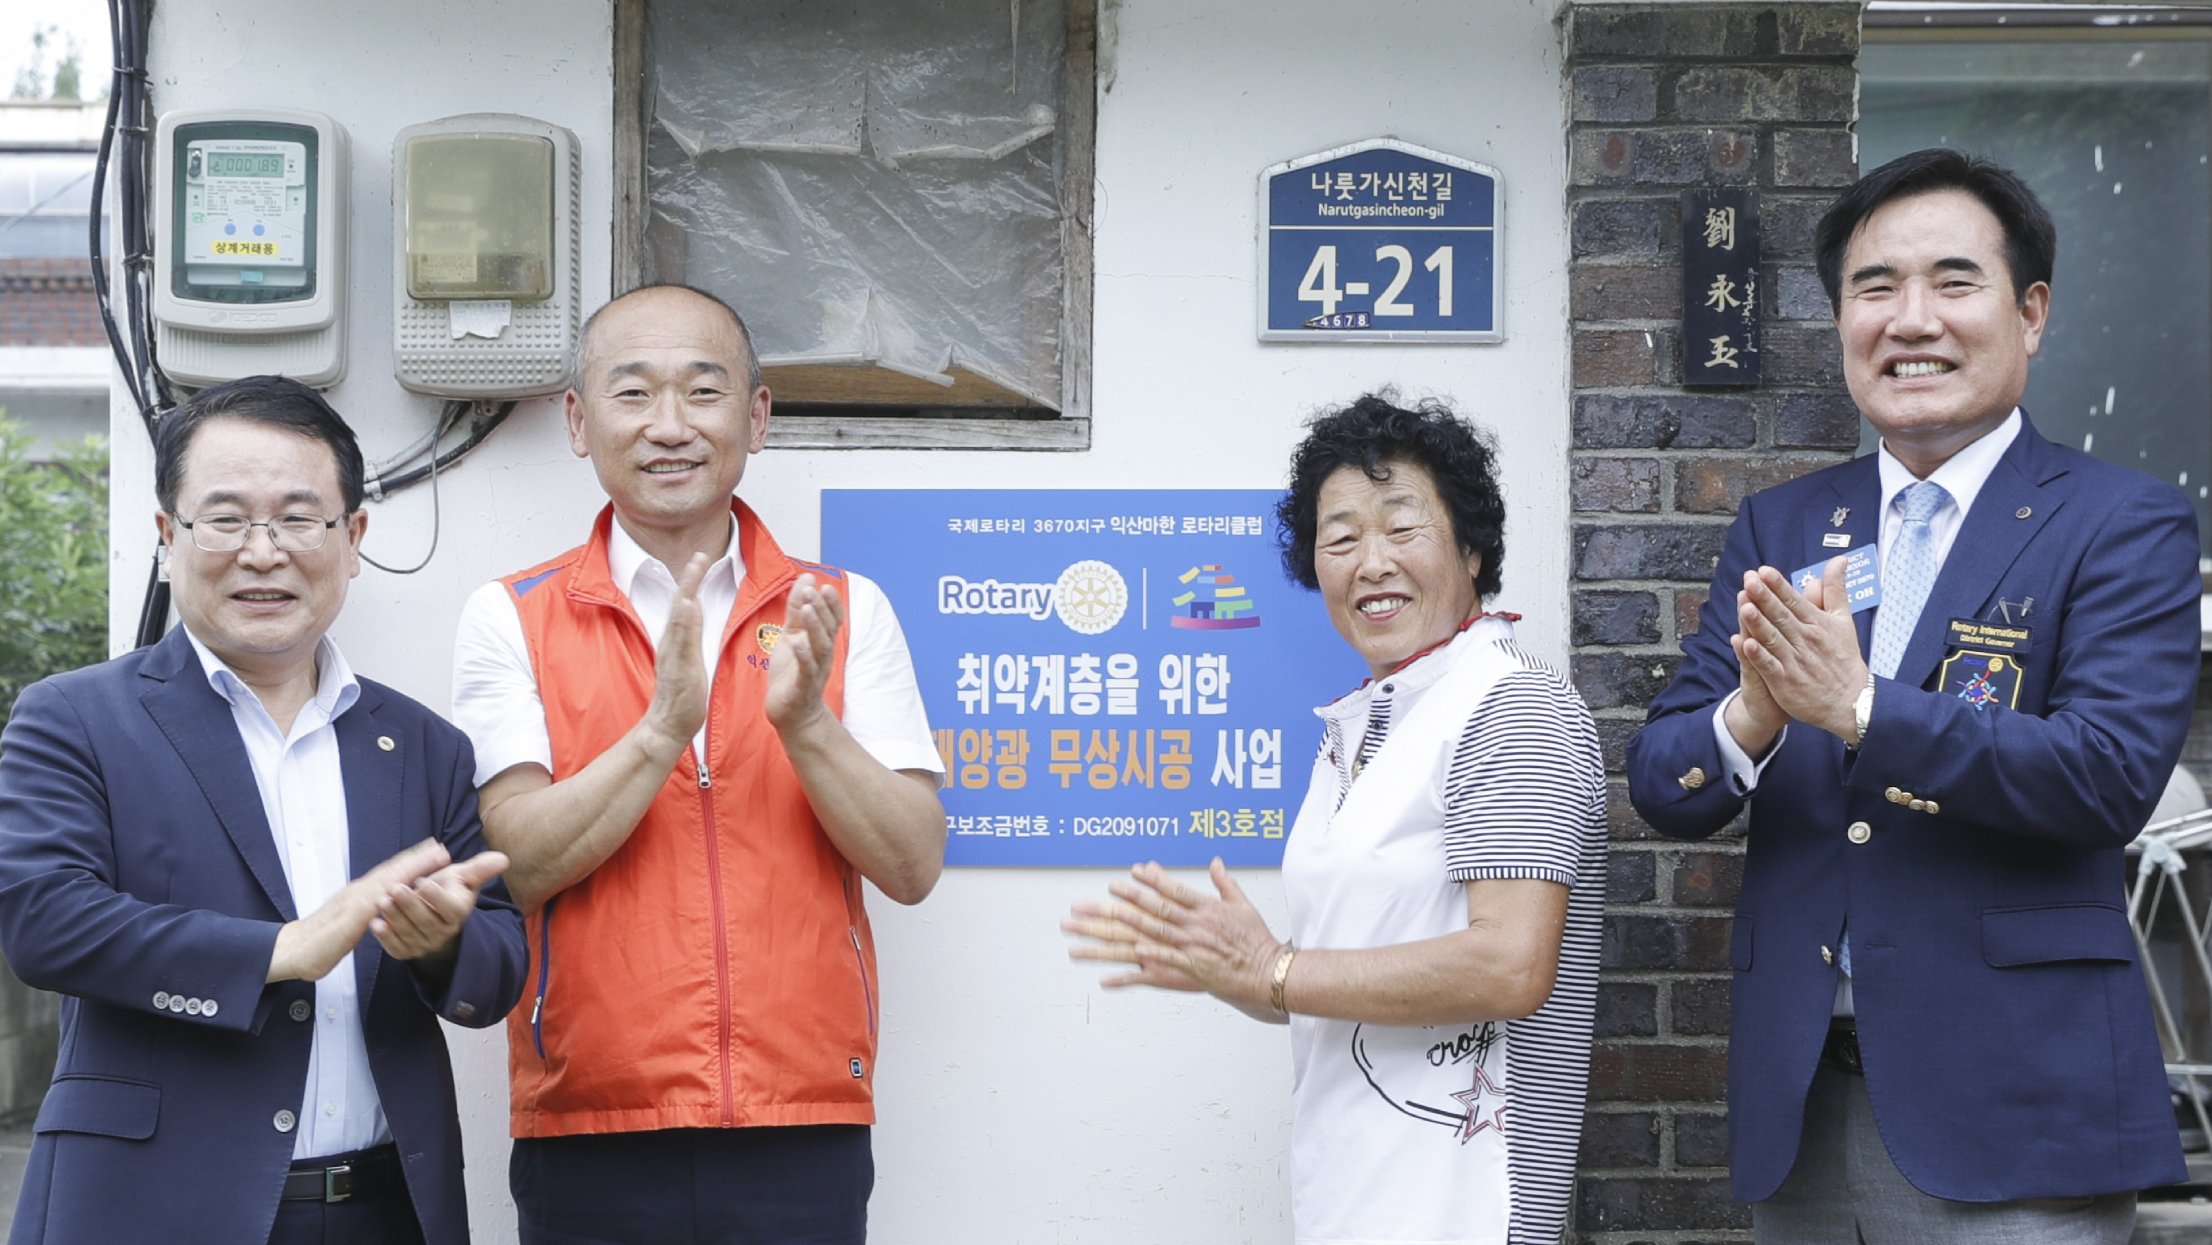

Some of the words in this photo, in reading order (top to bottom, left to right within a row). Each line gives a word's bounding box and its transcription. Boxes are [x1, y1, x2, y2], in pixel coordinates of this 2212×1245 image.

[1311, 172, 1452, 201] 나룻가신천길
[1318, 203, 1445, 219] Narutgasincheon-gil
[215, 241, 273, 255] 상계거래용
[1297, 244, 1453, 316] 4-21
[947, 518, 1026, 534] 국제로타리
[1034, 518, 1106, 534] 3670지구
[1110, 516, 1176, 535] 익산마한
[1180, 516, 1263, 535] 로타리클럽
[943, 580, 1052, 616] Rotary
[1855, 586, 1875, 600] OH
[1951, 621, 1978, 635] Rotary
[1979, 625, 2028, 639] International
[956, 652, 1140, 716] 취약계층을
[1158, 653, 1231, 715] 위한
[1048, 728, 1193, 790] 무상시공
[1211, 728, 1282, 789] 사업
[1073, 816, 1179, 836] DG2091071
[1188, 808, 1284, 839] 제3호점
